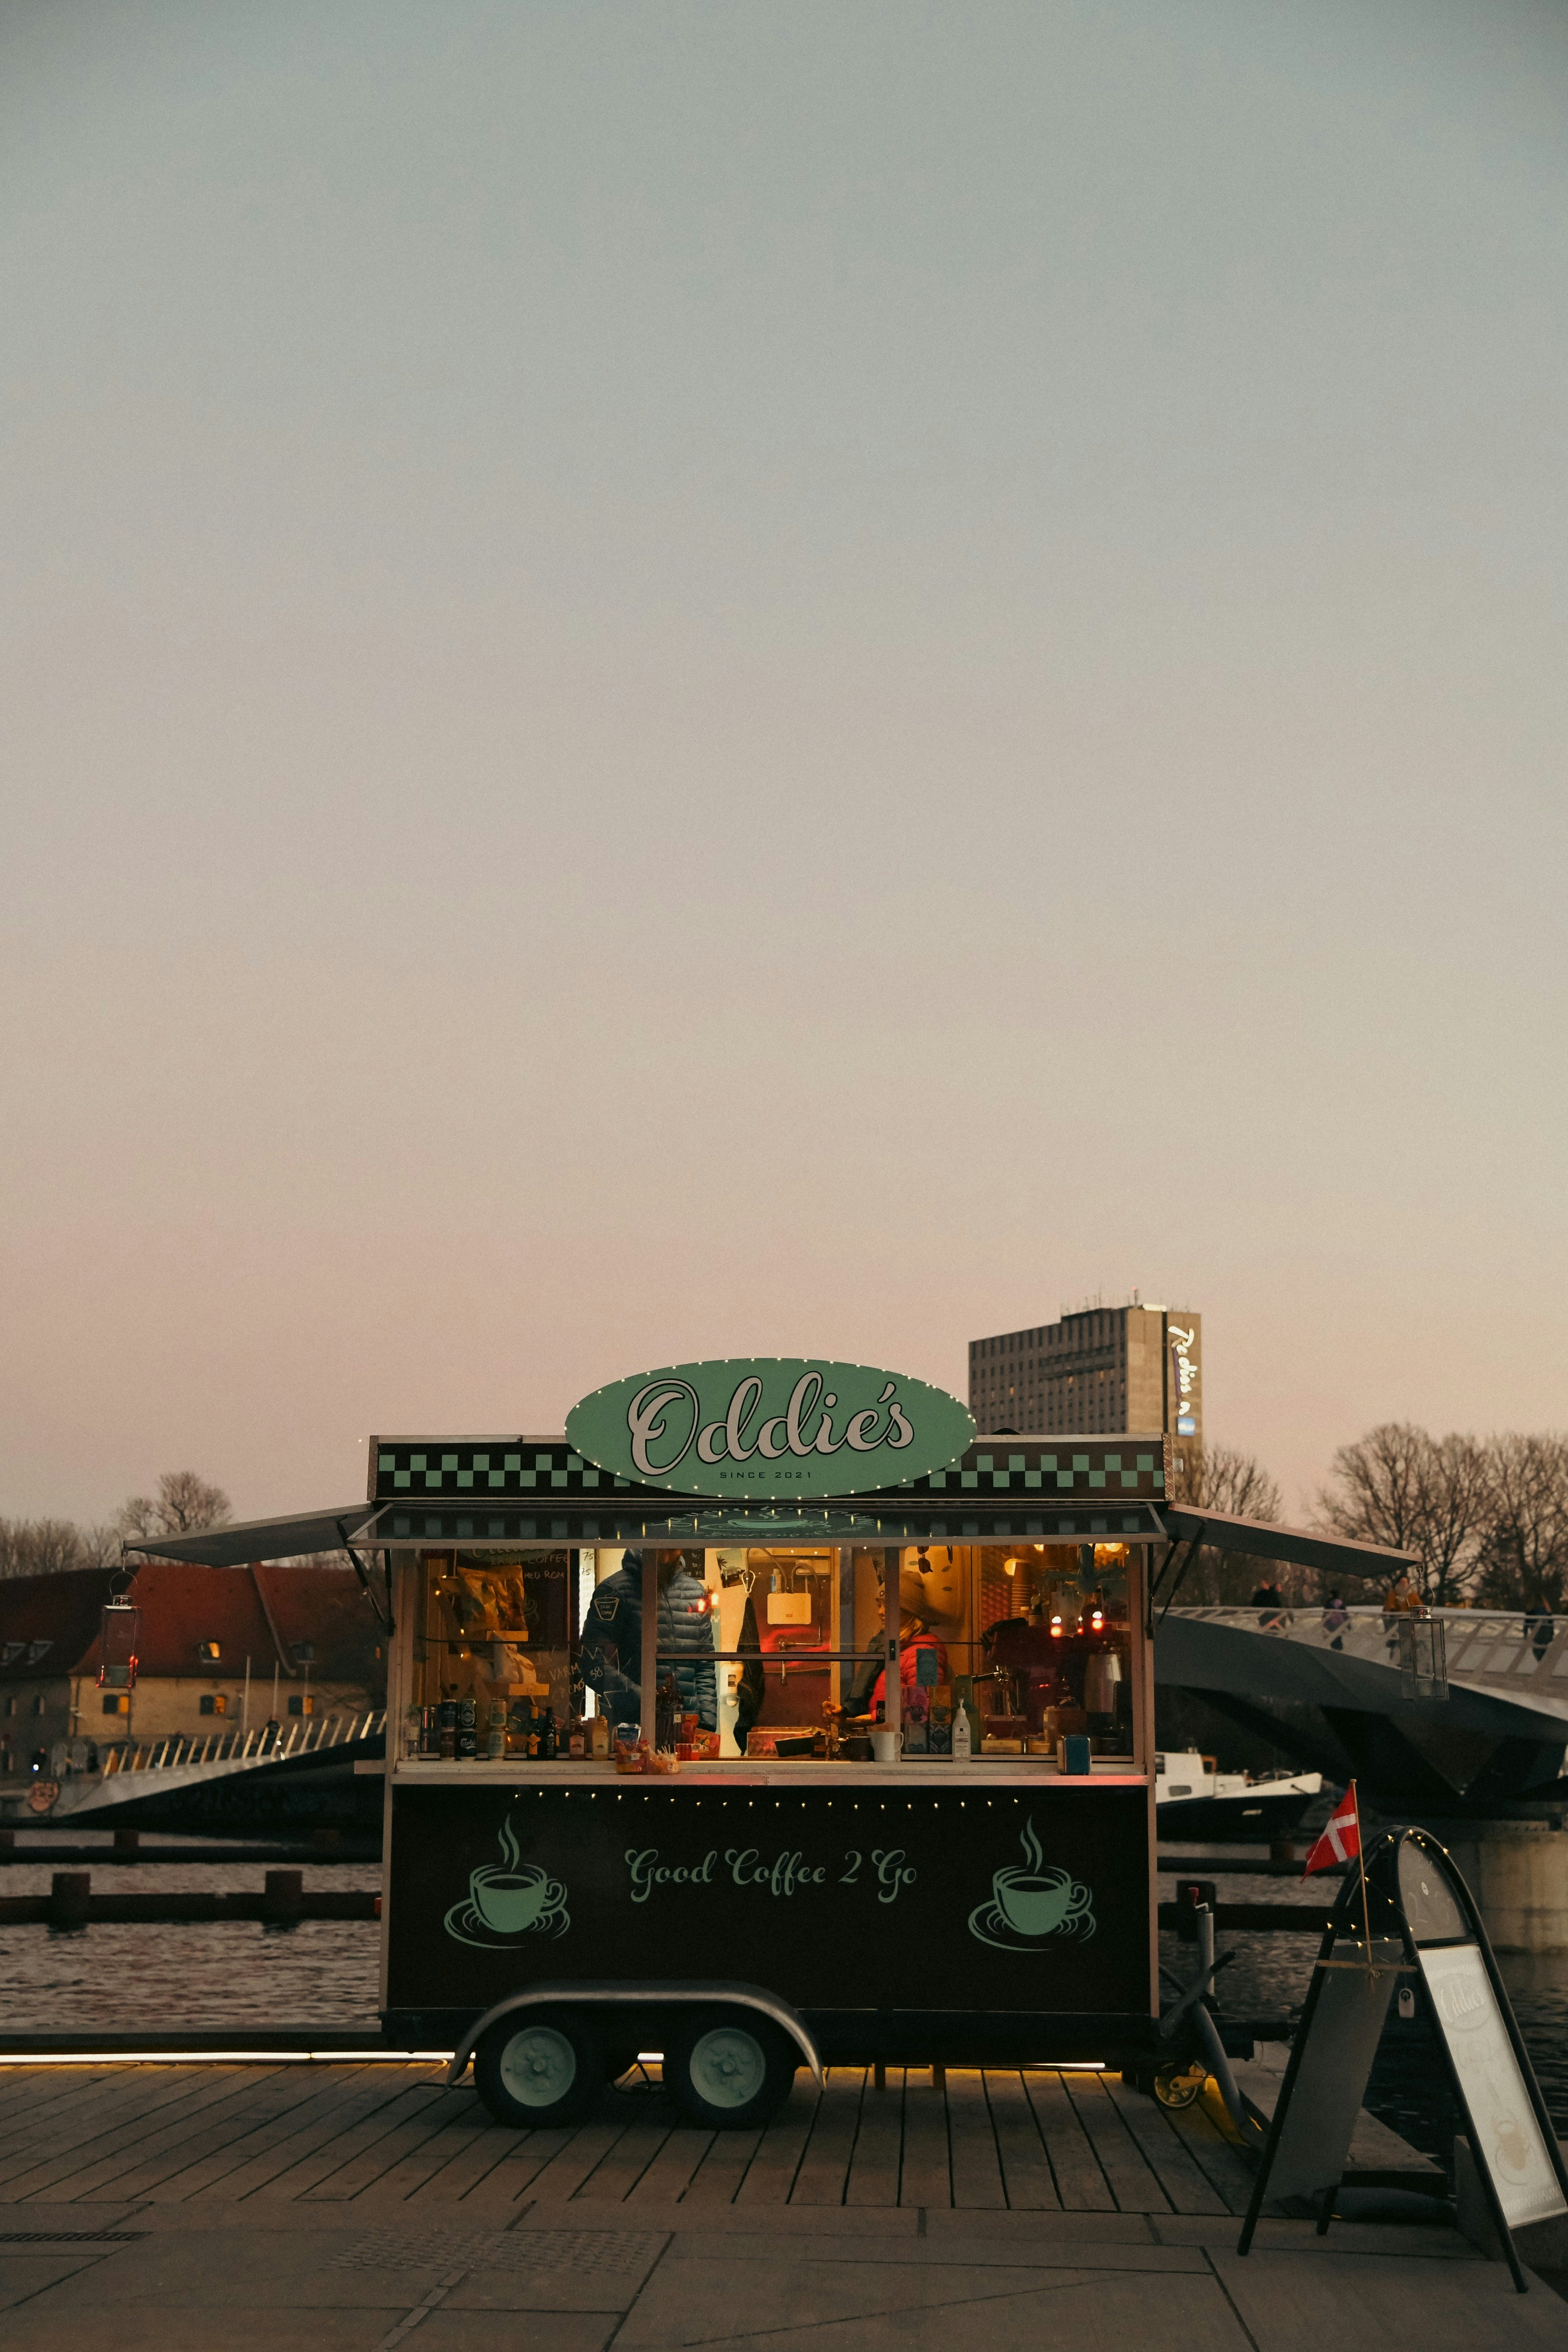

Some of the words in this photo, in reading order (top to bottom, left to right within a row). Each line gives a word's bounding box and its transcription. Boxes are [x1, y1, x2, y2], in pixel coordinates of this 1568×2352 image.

[1168, 1326, 1198, 1415] Radissn
[527, 1553, 568, 1564] COFFEE
[582, 1551, 595, 1562] 75
[544, 1570, 565, 1579] ROM
[549, 1662, 581, 1681] VARM
[624, 1848, 718, 1903] Good
[724, 1848, 826, 1896] Coffee
[838, 1850, 862, 1883] 2
[871, 1849, 917, 1903] Go
